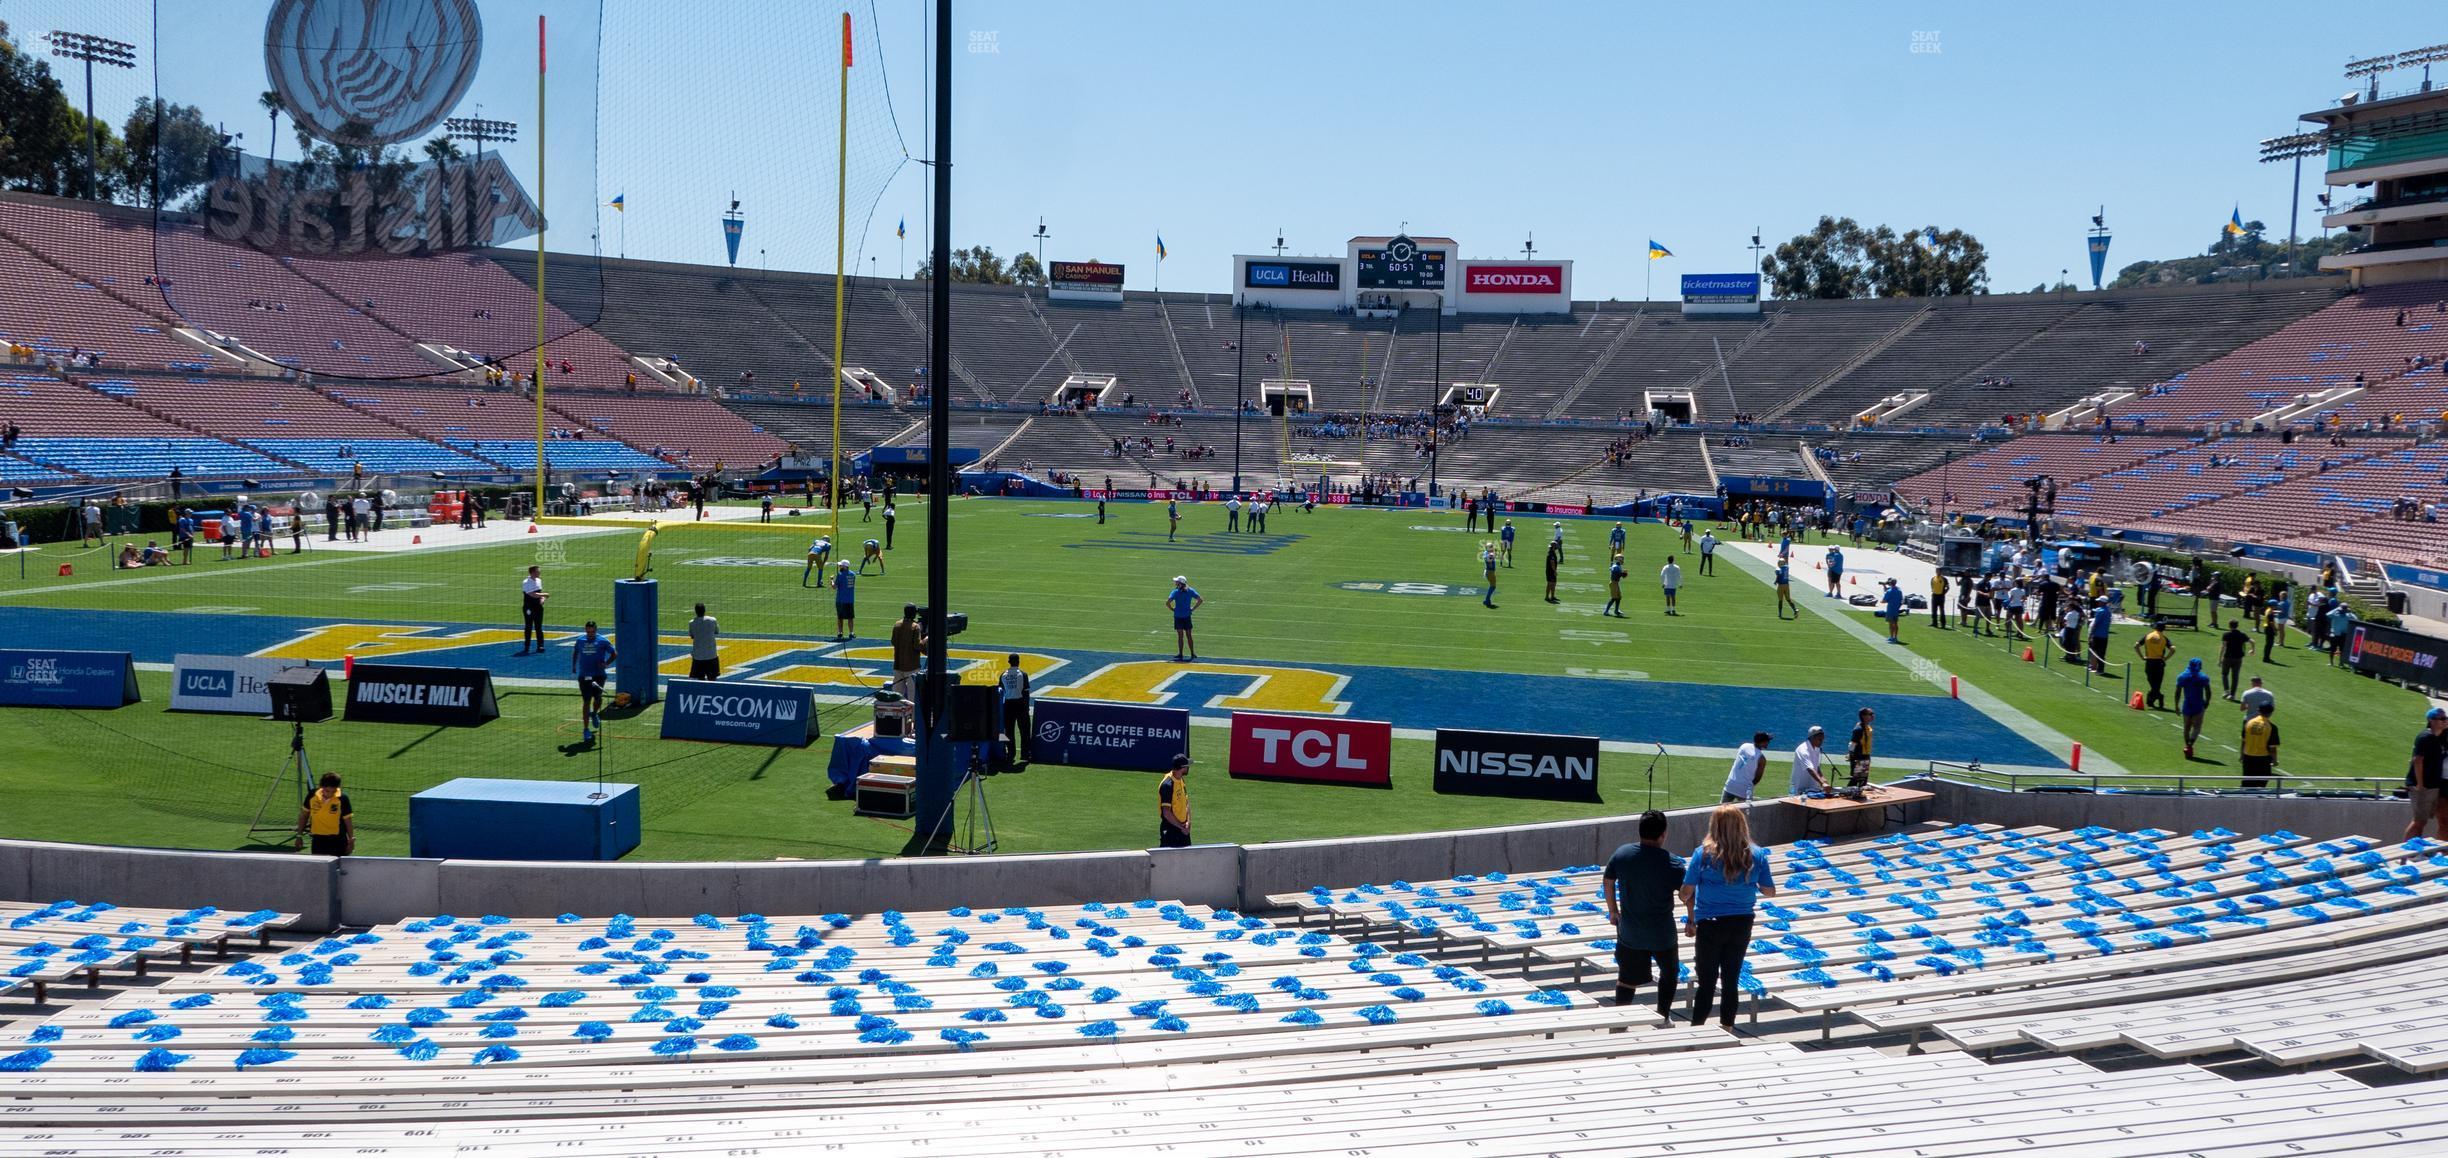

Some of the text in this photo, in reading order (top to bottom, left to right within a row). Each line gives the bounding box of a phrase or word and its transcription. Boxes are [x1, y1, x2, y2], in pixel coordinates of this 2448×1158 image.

[1065, 265, 1122, 276] SAN MANUEL
[1360, 262, 1364, 270] 3
[1389, 263, 1414, 271] 60:57
[1255, 269, 1334, 283] UCLA Health
[1472, 274, 1554, 286] HONDA
[1683, 279, 1753, 289] ticketmaster
[1466, 388, 1483, 400] 40
[1116, 490, 1147, 498] NISSAN
[1169, 491, 1193, 500] TCL
[1855, 492, 1889, 503] HONDA
[1554, 506, 1583, 515] Insurance
[2420, 652, 2439, 669] PAY
[86, 667, 115, 676] Dealers
[187, 675, 227, 691] UCLA
[357, 681, 472, 707] MUSCLE MILK
[679, 693, 773, 719] WESCOM
[715, 719, 760, 730] wescom.org
[1070, 721, 1181, 740] THE COFFEE BEAN
[1069, 734, 1137, 749] & TEA LEAF
[1252, 727, 1368, 770] TCL
[1440, 749, 1593, 781] NISSAN
